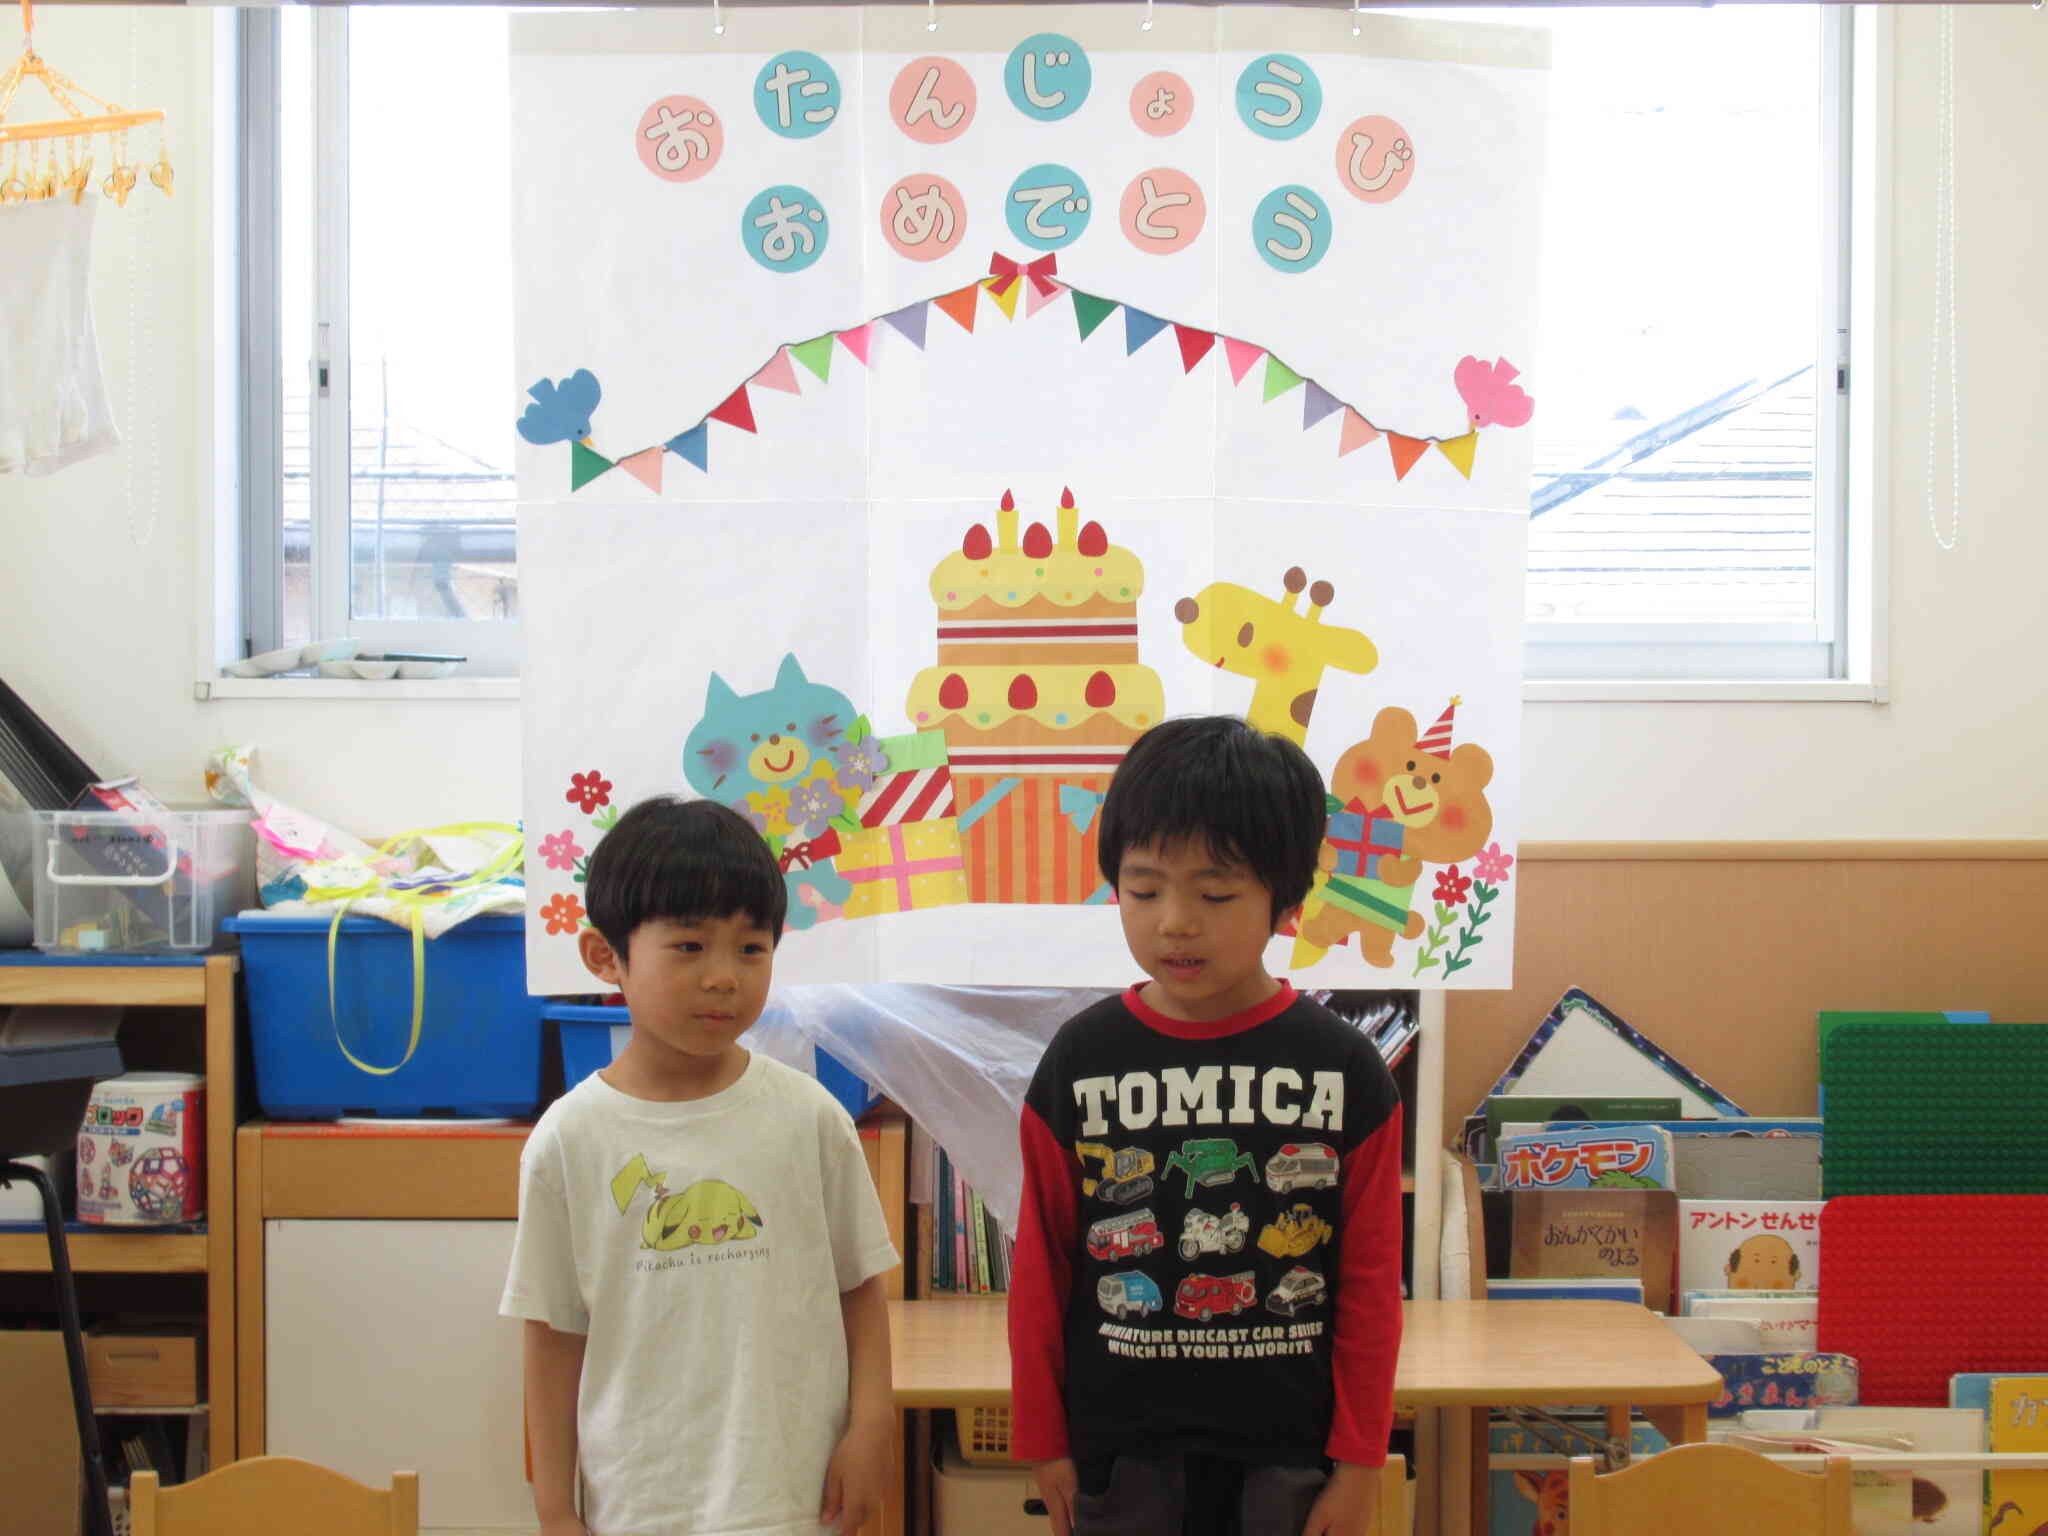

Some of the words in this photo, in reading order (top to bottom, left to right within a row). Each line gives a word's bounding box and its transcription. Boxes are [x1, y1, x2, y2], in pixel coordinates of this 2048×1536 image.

[754, 183, 1320, 263] おめでとう
[1072, 1065, 1344, 1136] TOMICA
[1504, 1140, 1652, 1186] ポケモン
[1689, 1211, 1819, 1231] アントンせんせ
[1544, 1223, 1639, 1246] おんがくかい
[1598, 1247, 1639, 1267] のよる
[1098, 1322, 1173, 1344] MINIATURE
[1176, 1328, 1249, 1344] DIECAST
[1252, 1326, 1285, 1341] CAR
[1107, 1339, 1157, 1359] WHICH
[1160, 1344, 1177, 1359] IS
[1180, 1344, 1231, 1359] YOUR
